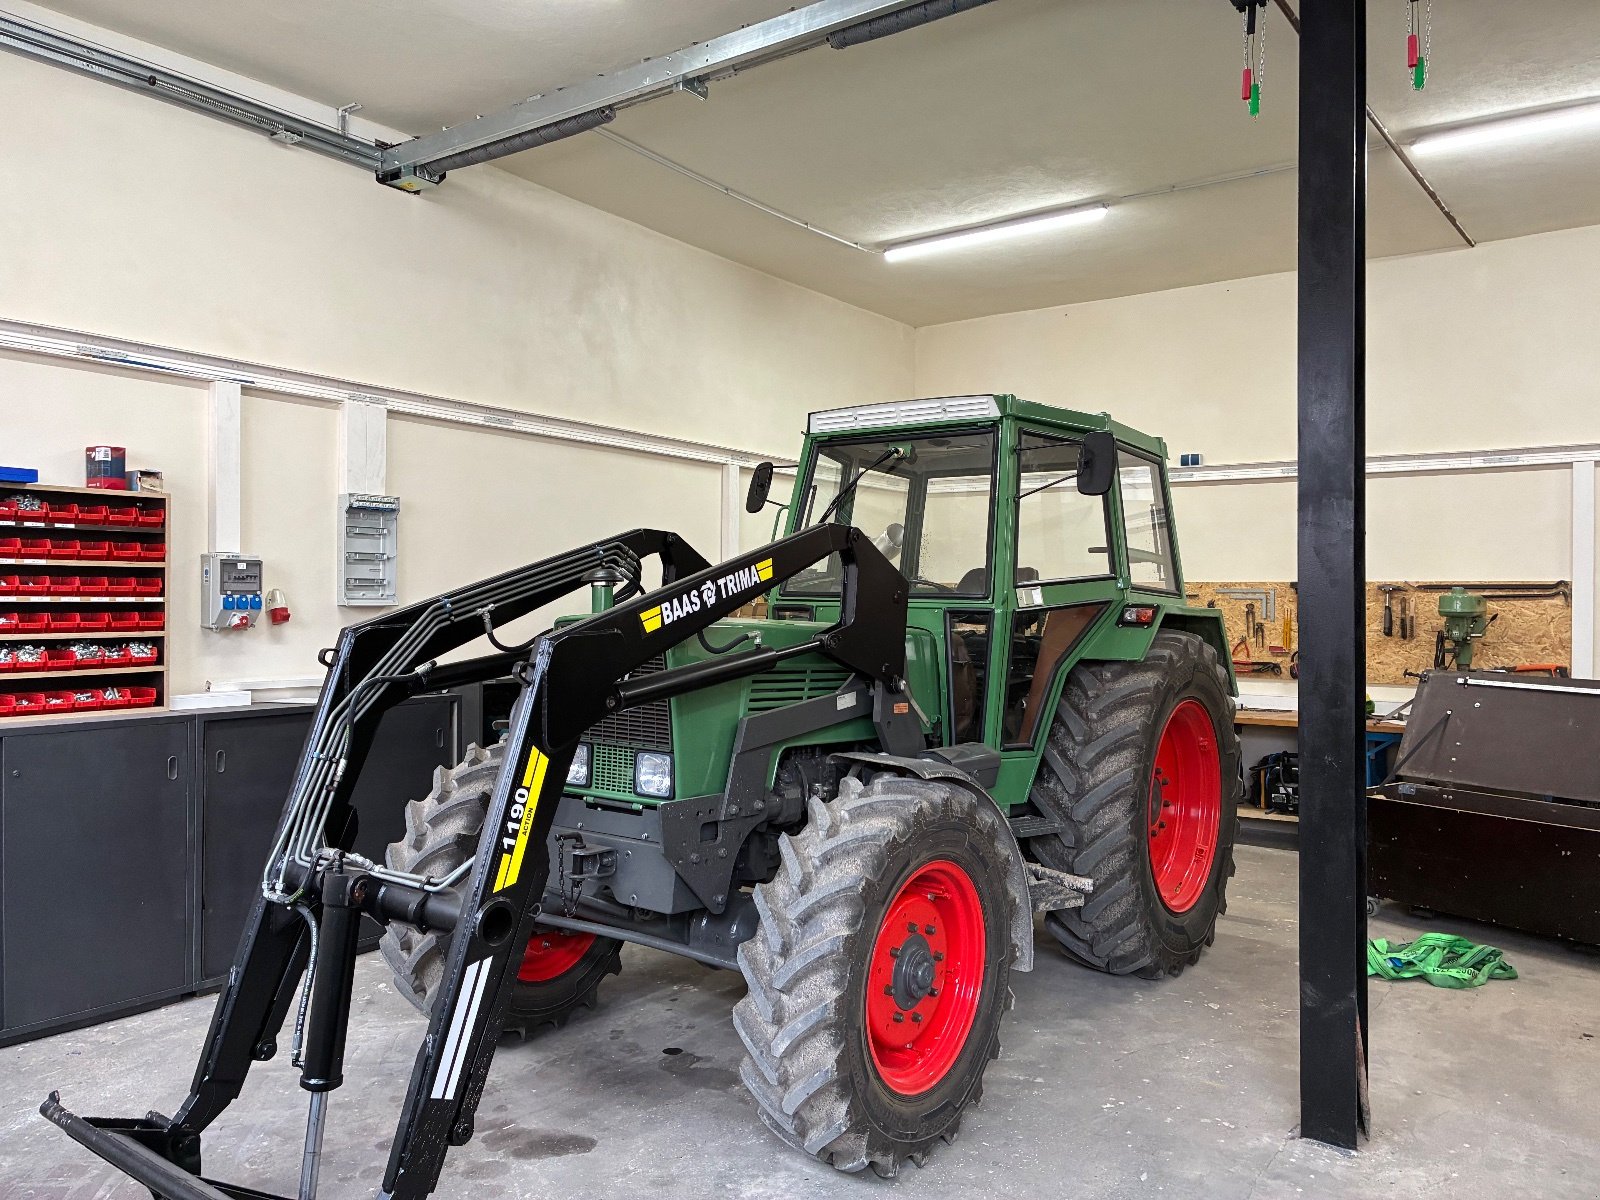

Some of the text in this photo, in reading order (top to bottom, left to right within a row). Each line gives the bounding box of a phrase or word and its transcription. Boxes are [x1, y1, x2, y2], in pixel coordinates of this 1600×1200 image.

[661, 565, 760, 625] BAAS TRIMA
[502, 787, 529, 850] 1190
[522, 807, 533, 836] ACTION
